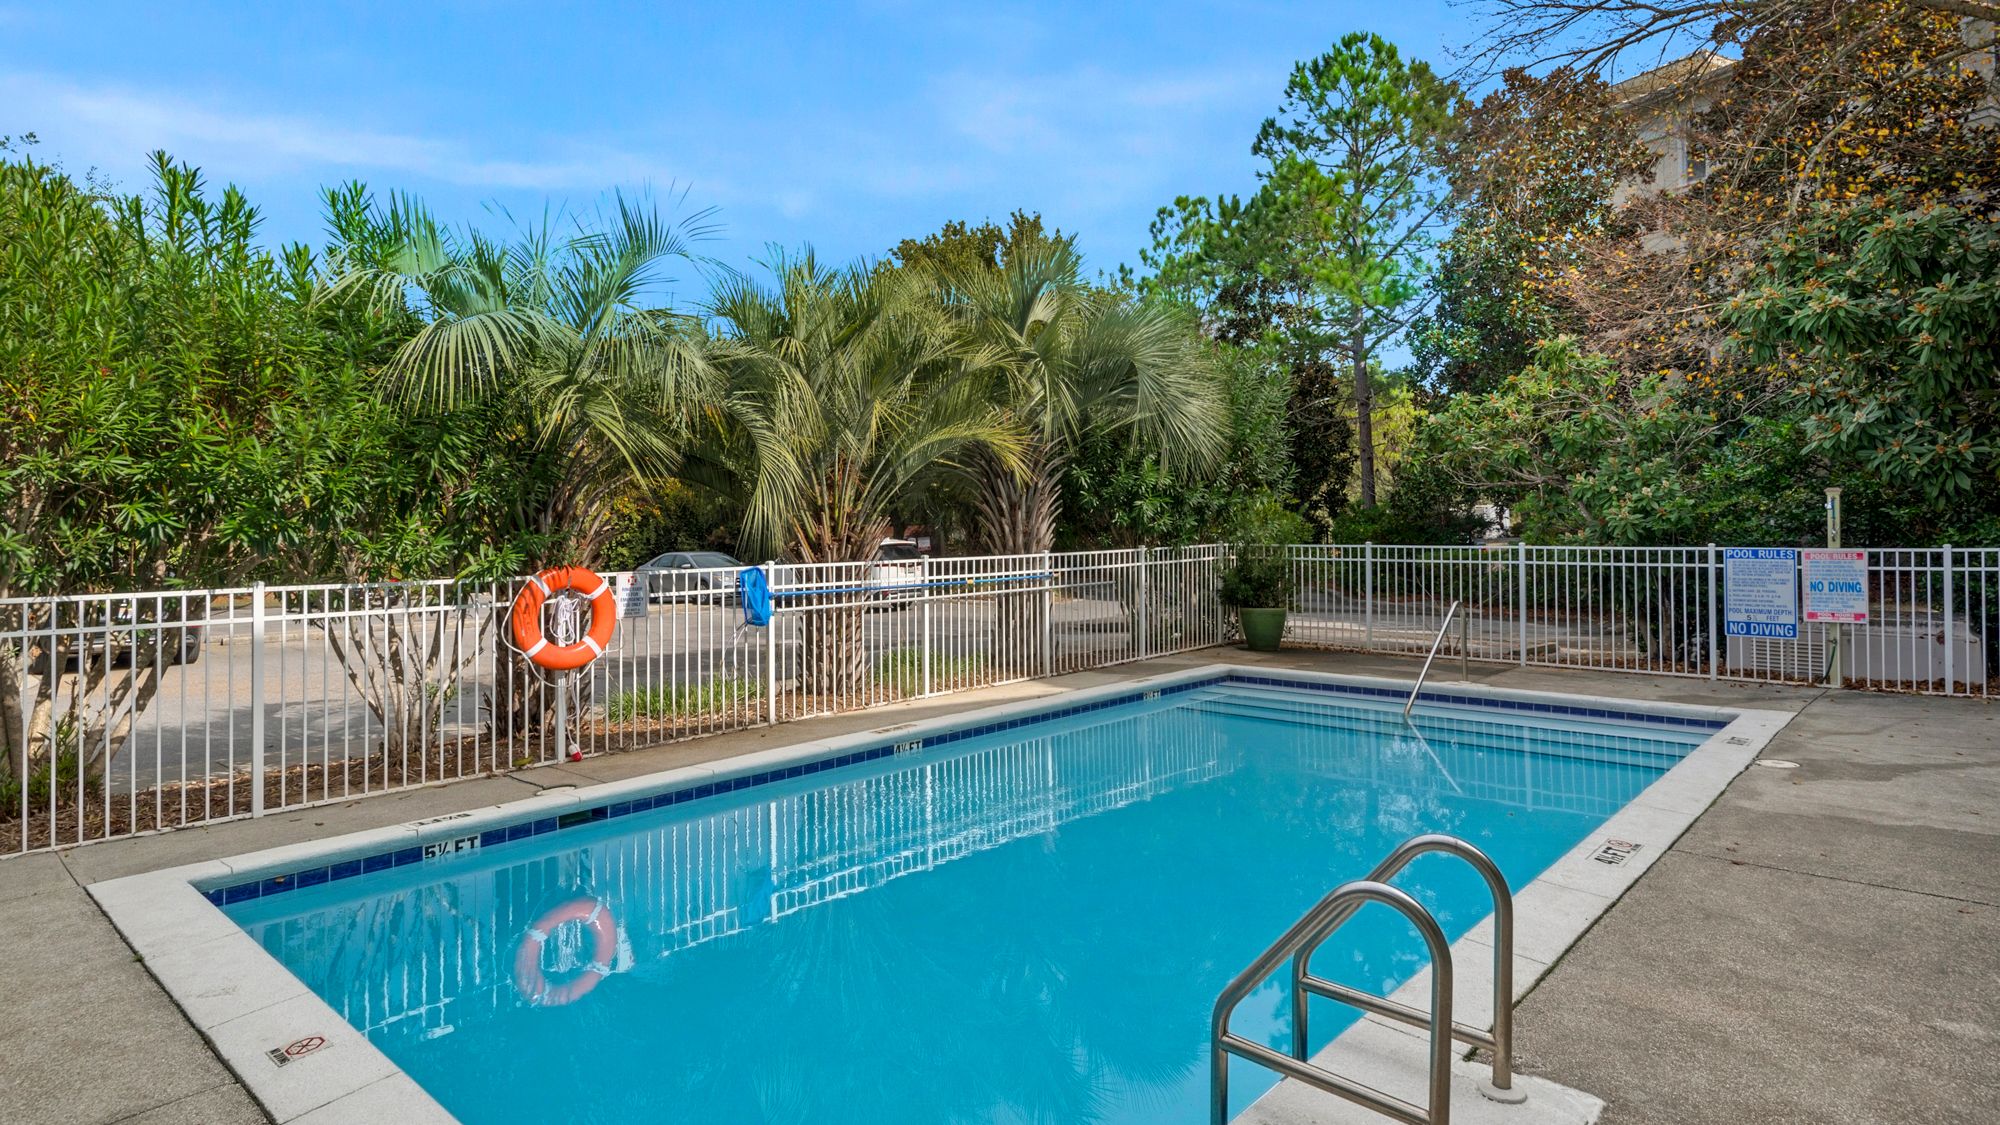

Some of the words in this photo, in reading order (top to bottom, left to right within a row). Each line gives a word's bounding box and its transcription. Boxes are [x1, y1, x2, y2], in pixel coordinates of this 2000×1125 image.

[1727, 550, 1755, 558] POOL
[1758, 550, 1794, 559] RULES
[1810, 552, 1830, 560] POOL
[1833, 552, 1857, 560] RULES
[1810, 581, 1824, 592] NO
[1730, 622, 1747, 634] NO
[1750, 623, 1794, 637] DIVING
[909, 740, 921, 751] FT
[454, 835, 478, 853] FT
